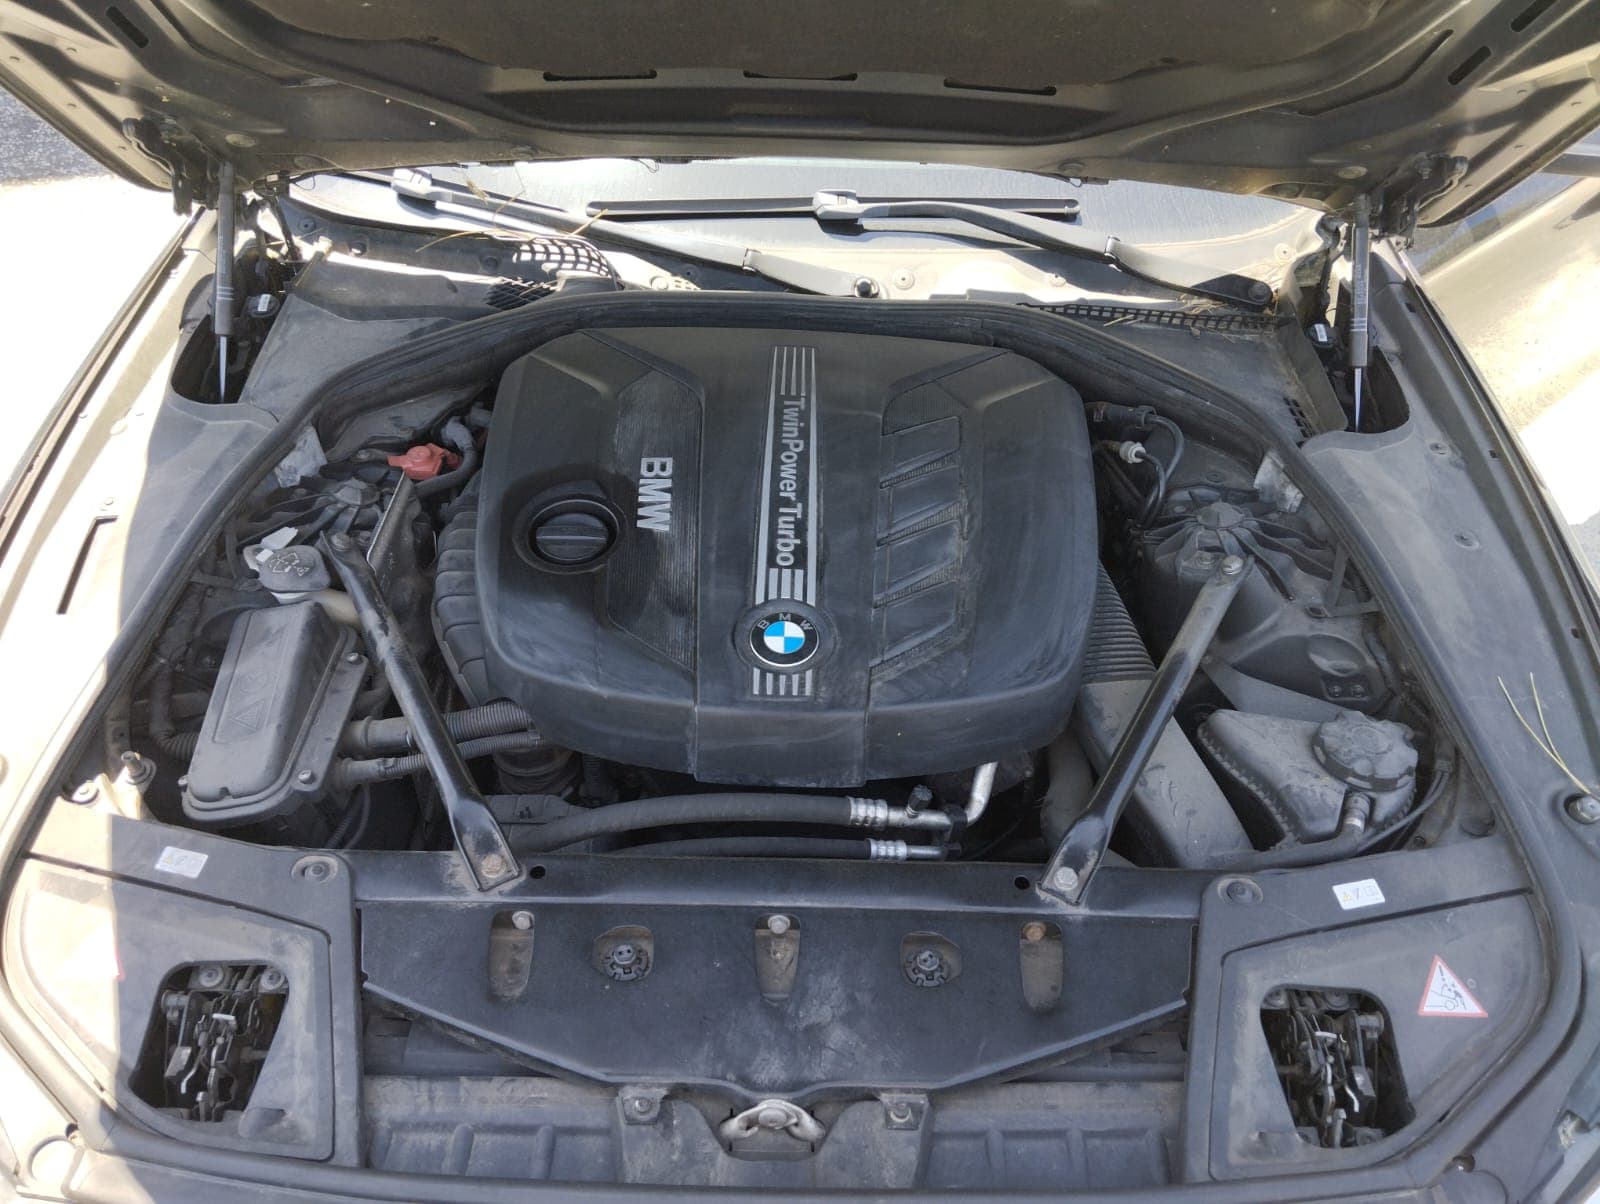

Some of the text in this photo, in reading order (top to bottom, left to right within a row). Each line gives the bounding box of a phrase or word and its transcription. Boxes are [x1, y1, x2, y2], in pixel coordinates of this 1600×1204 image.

[636, 456, 674, 532] BMW
[775, 397, 805, 567] TwinPower Turbo
[757, 612, 814, 631] BMW
